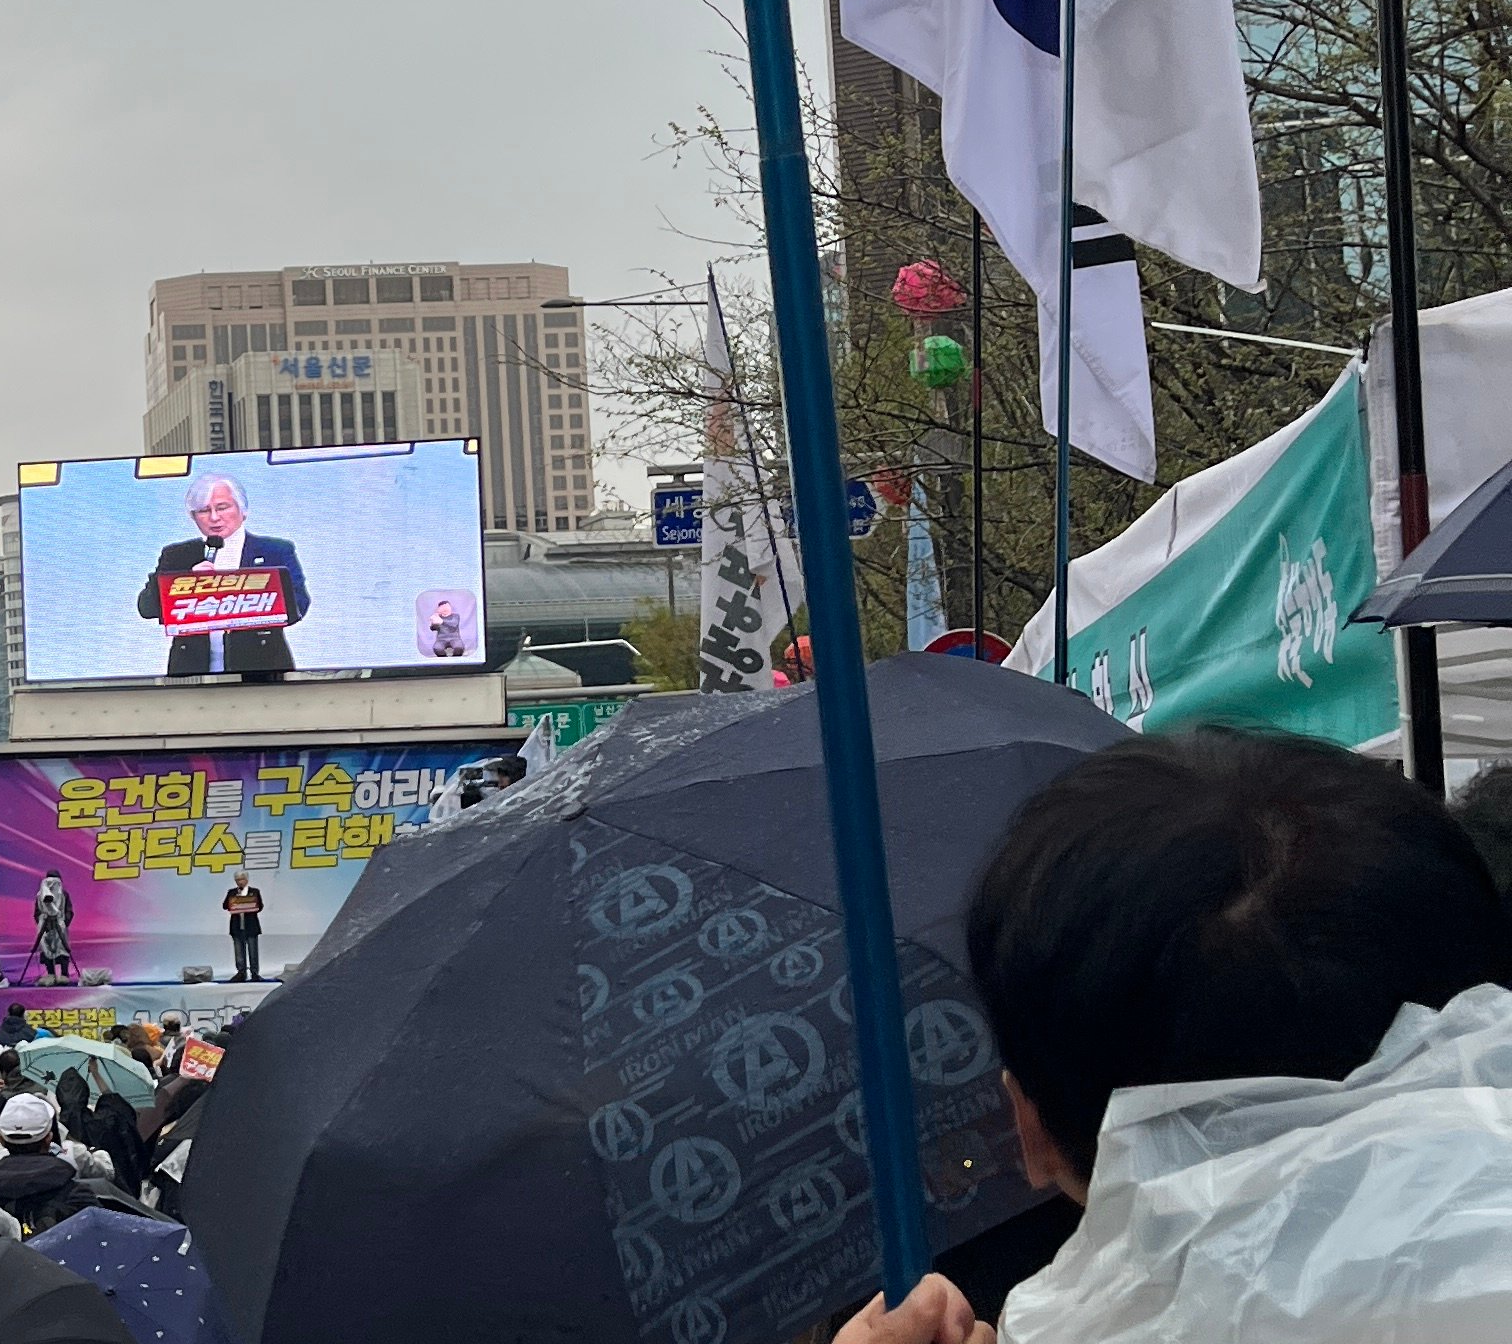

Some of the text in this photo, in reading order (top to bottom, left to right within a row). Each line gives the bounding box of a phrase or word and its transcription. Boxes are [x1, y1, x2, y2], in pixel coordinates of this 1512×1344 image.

[324, 265, 357, 277] SEOUL
[361, 265, 406, 276] FINANCE
[407, 264, 448, 275] CENTER
[279, 355, 372, 379] 서울신문
[169, 573, 271, 596] 윤건희를
[170, 592, 278, 621] 구속하라!
[522, 713, 572, 729] 광문
[57, 762, 446, 829] 윤건희를 구속하라!
[93, 812, 428, 881] 한덕수를 탄핵
[618, 1003, 750, 1087] IRON MAN
